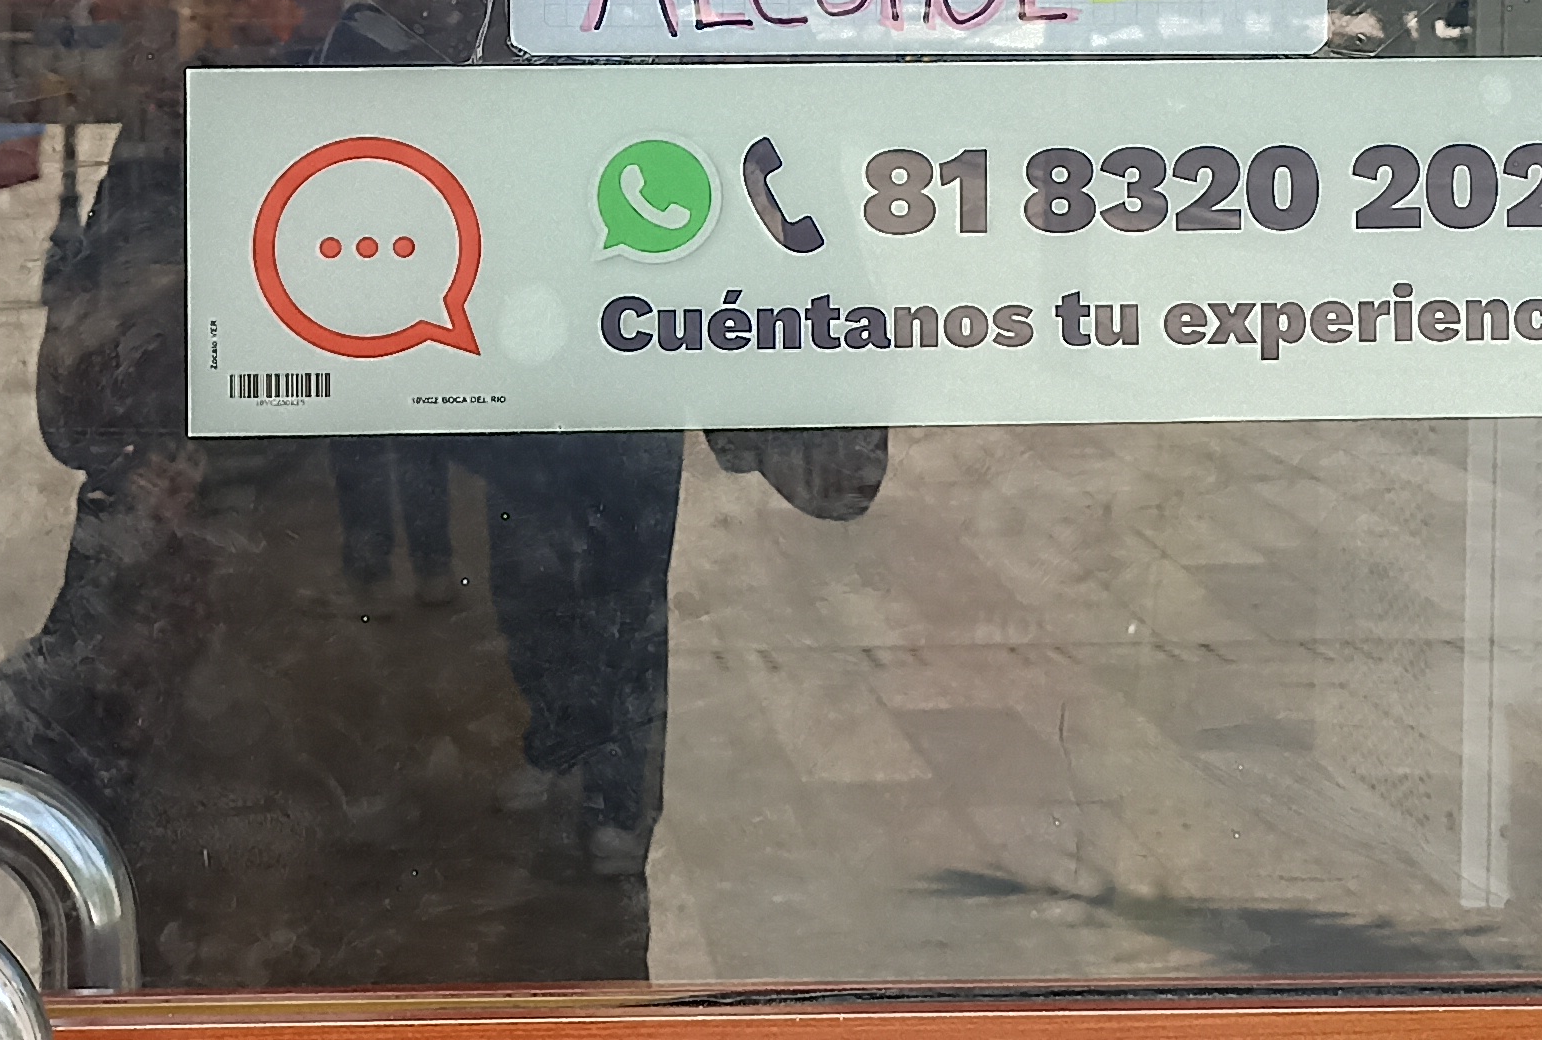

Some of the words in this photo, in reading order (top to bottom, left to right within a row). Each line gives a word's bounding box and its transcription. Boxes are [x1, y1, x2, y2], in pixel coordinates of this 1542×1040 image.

[862, 147, 989, 235] 81
[1023, 144, 1320, 234] 8320
[601, 289, 1036, 353] Cuéntanos
[1055, 289, 1139, 348] tu
[441, 396, 468, 404] BOCA
[490, 395, 507, 404] RIO
